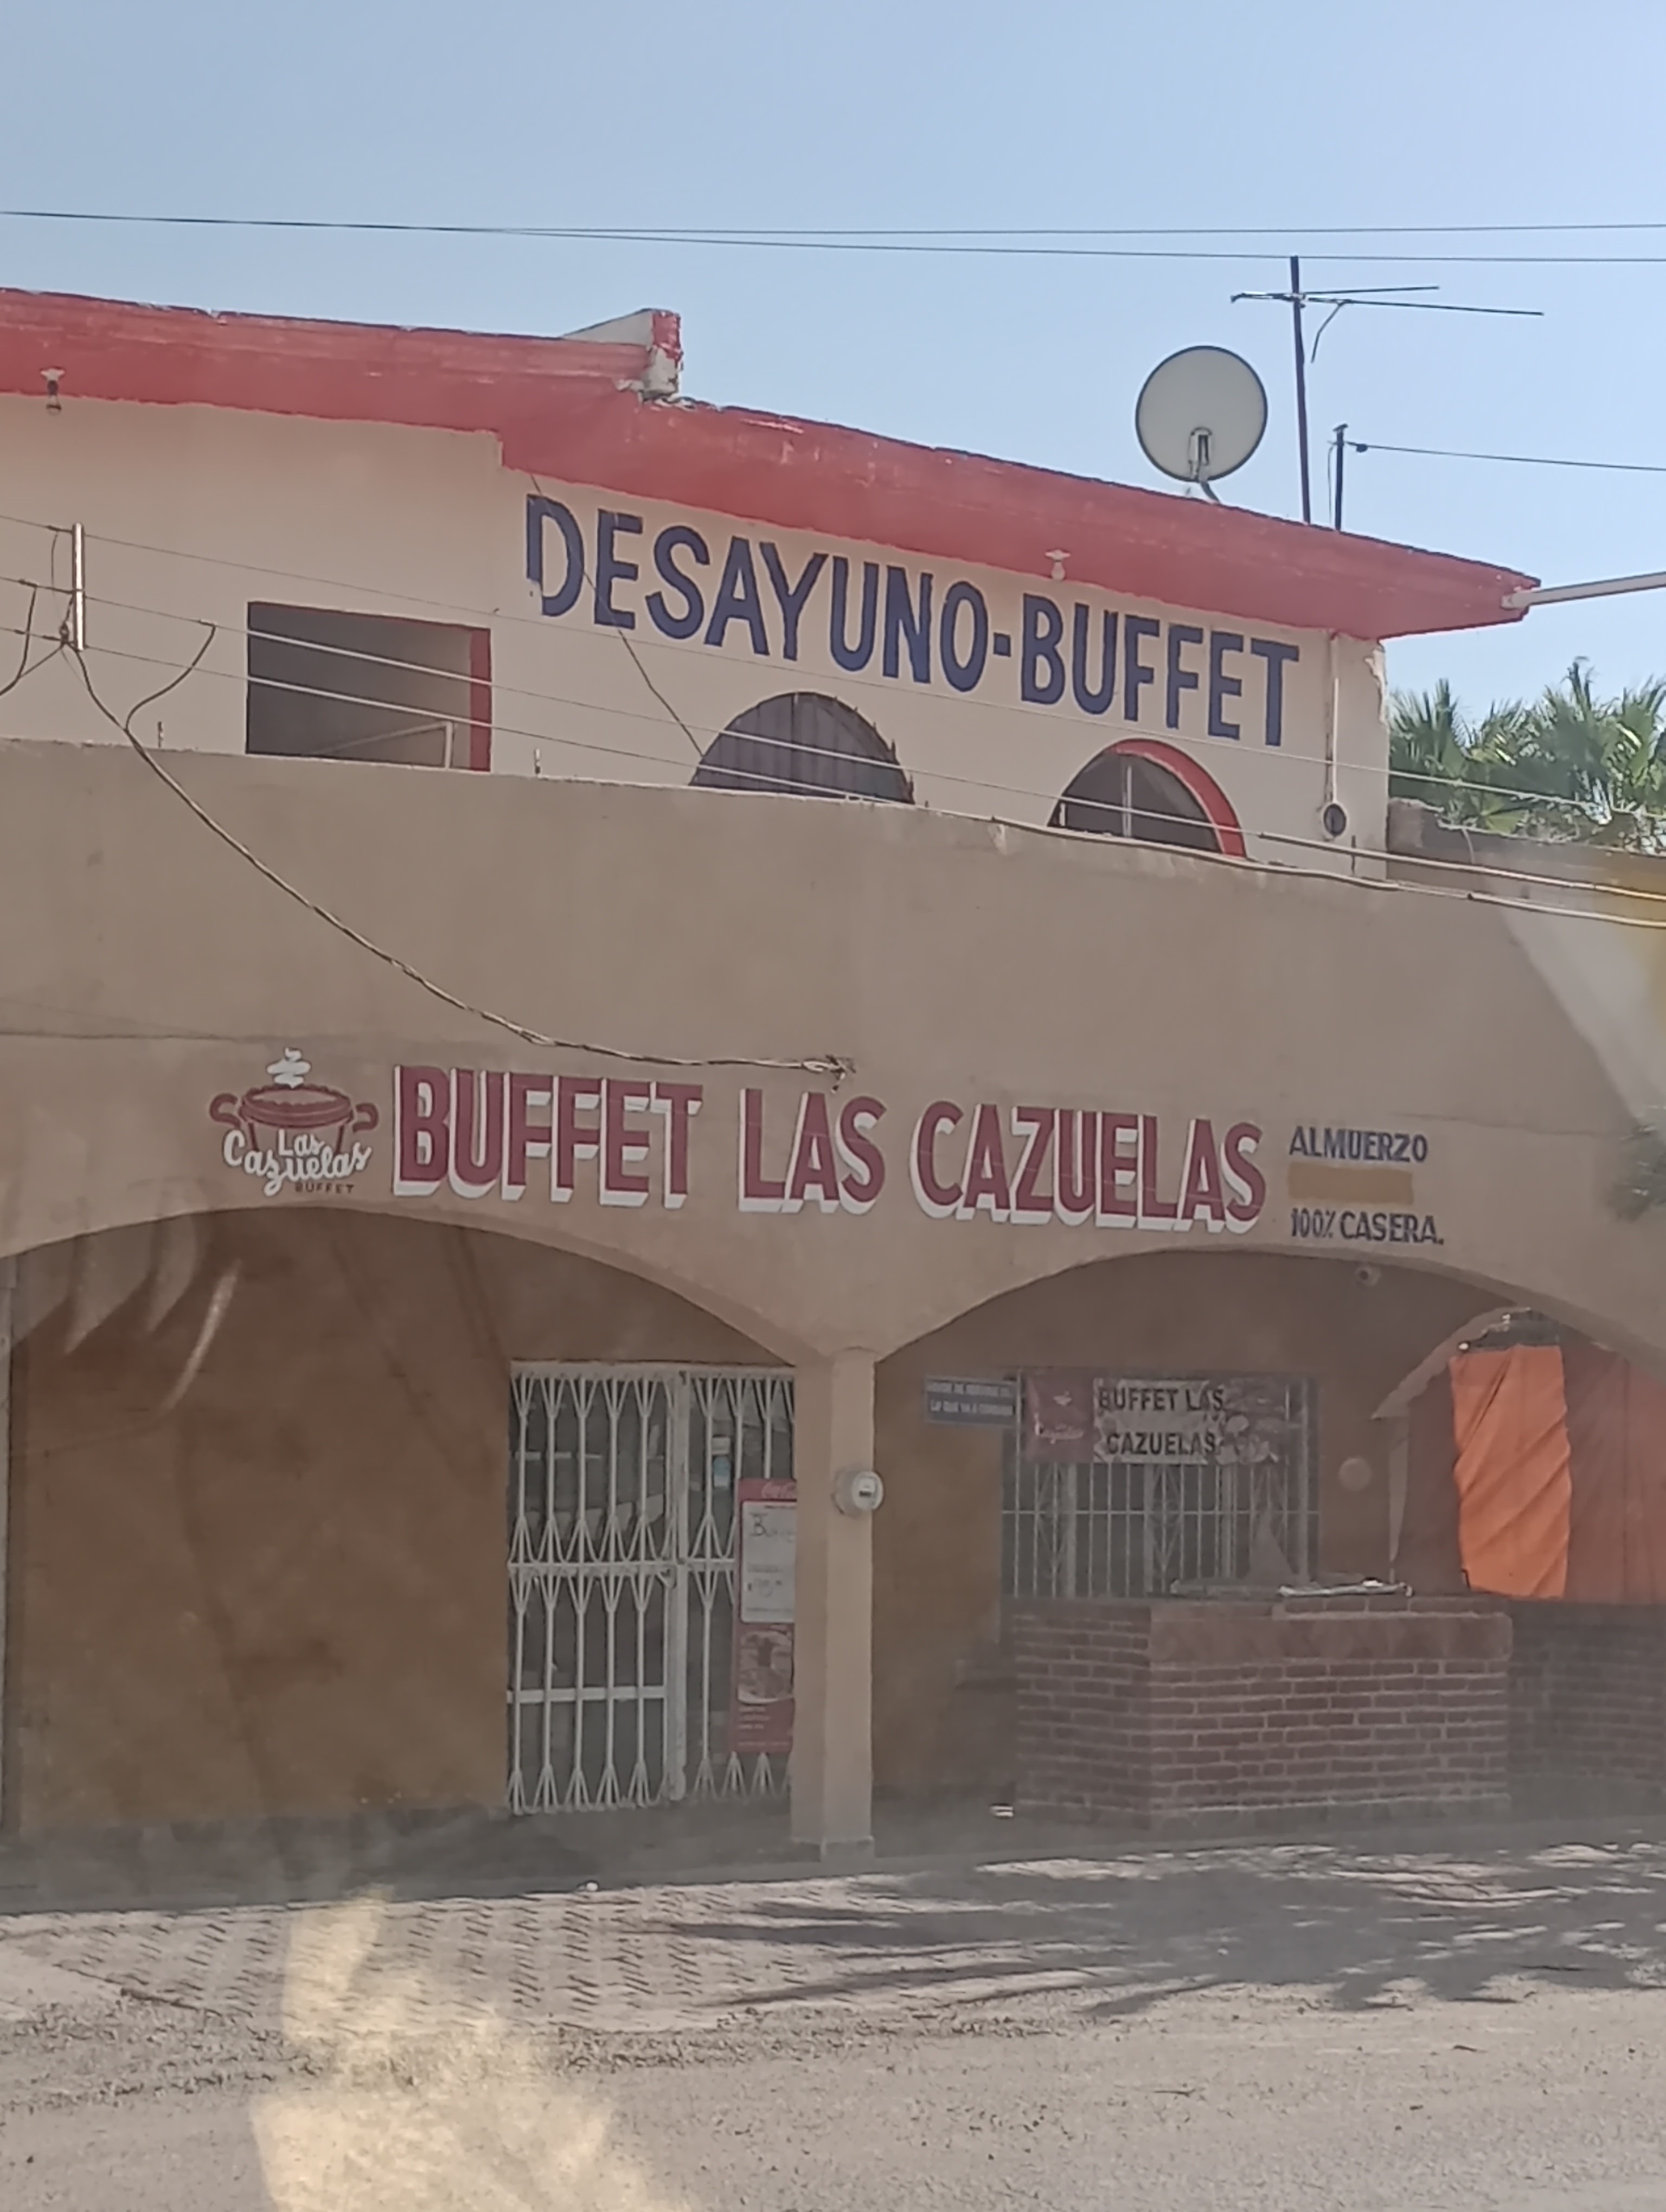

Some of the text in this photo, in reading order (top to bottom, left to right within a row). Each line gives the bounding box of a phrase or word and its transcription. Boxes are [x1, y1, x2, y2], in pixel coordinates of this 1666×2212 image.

[278, 1128, 324, 1156] Las
[393, 1065, 1266, 1234] BUFFET LAS CAZUELAS
[1289, 1126, 1428, 1162] ALMUERZO
[223, 1129, 372, 1197] Cazuelas
[295, 1181, 355, 1194] BUFFET
[1291, 1207, 1444, 1245] 100% CASERA.
[1098, 1388, 1223, 1411] BUFFET LAS
[1106, 1432, 1217, 1455] CAZUELAS
